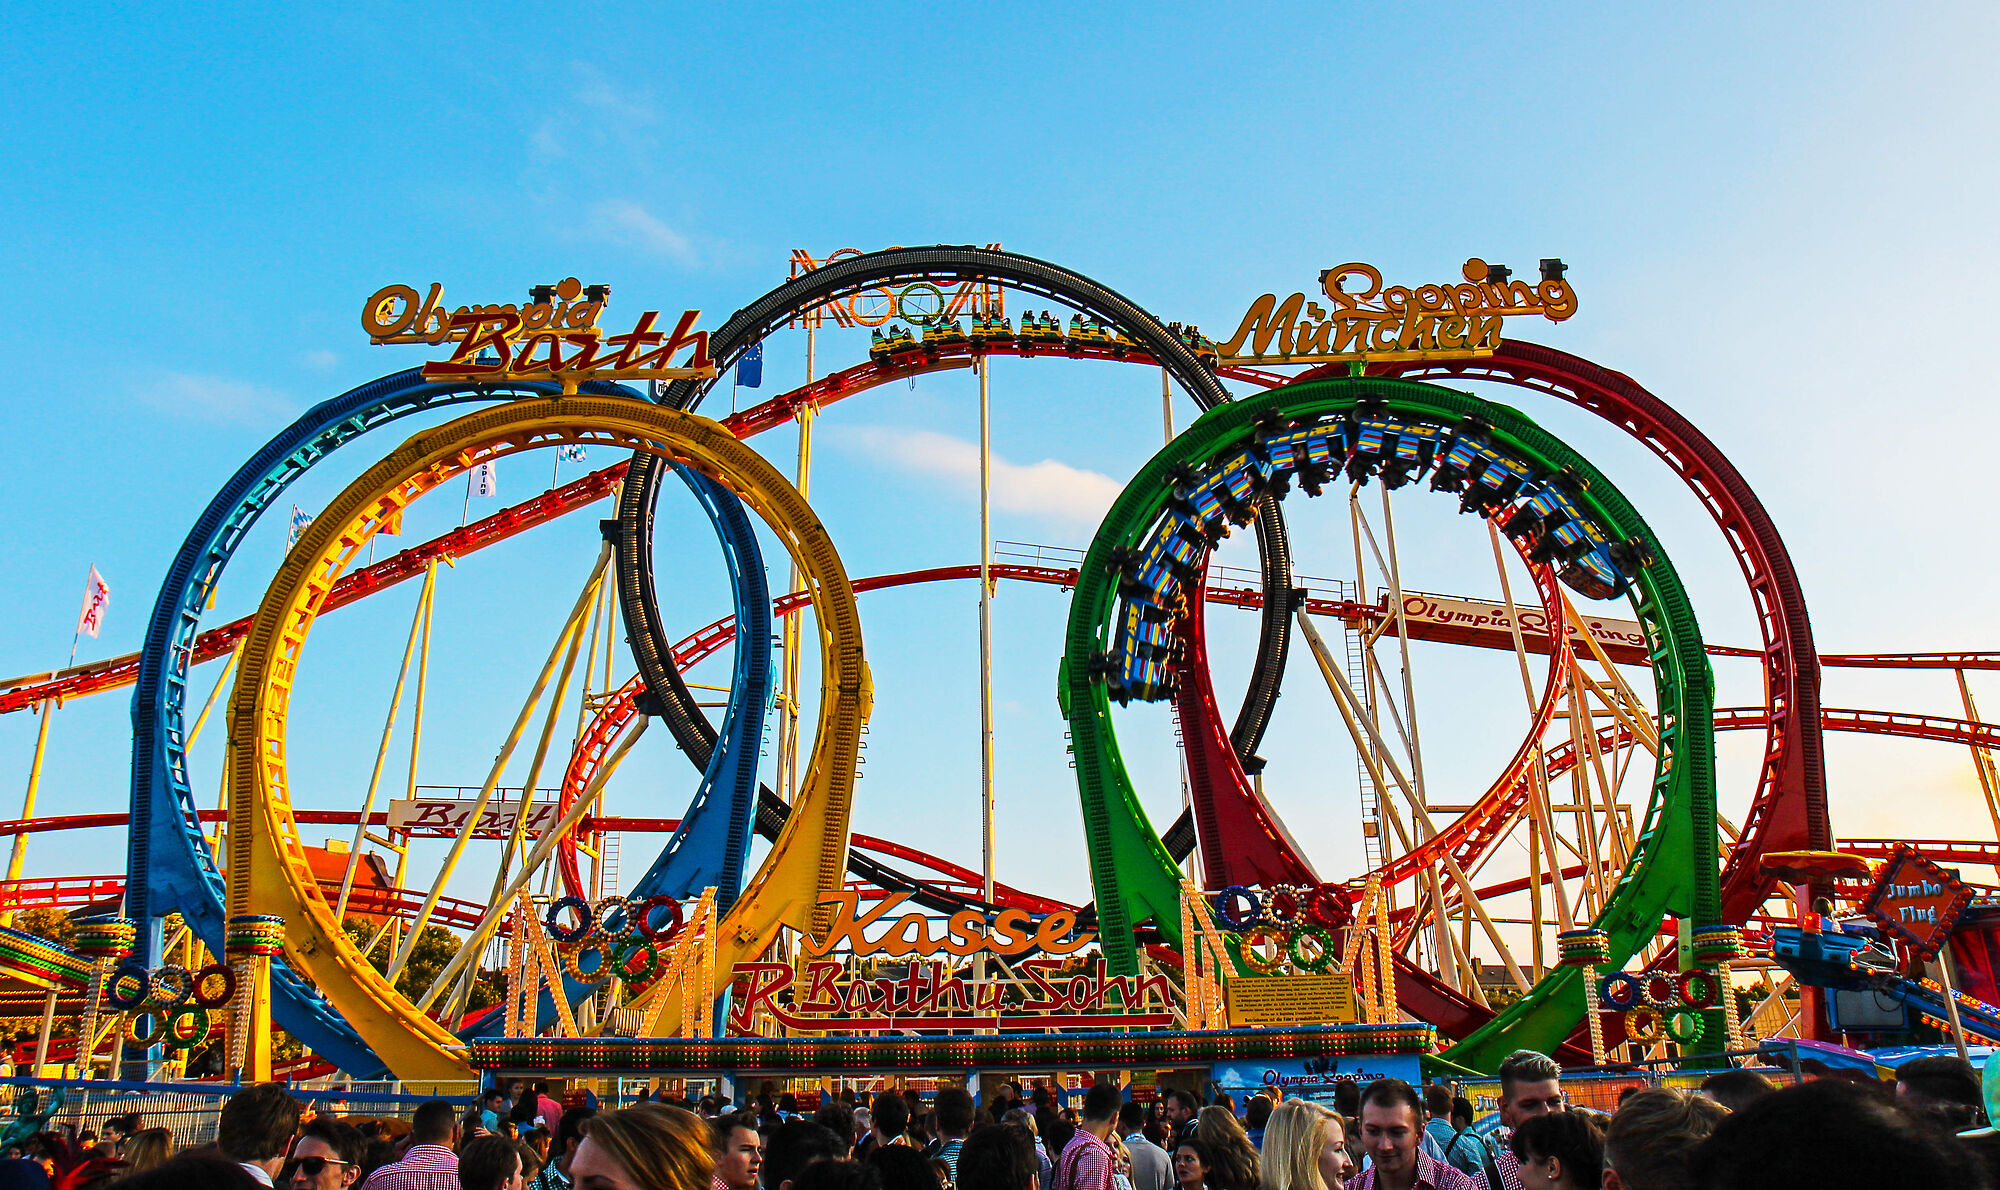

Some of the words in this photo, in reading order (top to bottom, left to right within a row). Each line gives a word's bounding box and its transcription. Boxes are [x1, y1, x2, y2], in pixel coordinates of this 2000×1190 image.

[1325, 258, 1578, 321] Looping
[1216, 292, 1503, 357] München
[420, 310, 715, 375] Barth
[480, 463, 488, 495] oping
[1402, 597, 1512, 628] Olympia
[1887, 879, 1943, 899] Jumbo
[799, 891, 1099, 957] Kasse
[1898, 905, 1938, 924] Flug
[1262, 1069, 1319, 1087] Olympia
